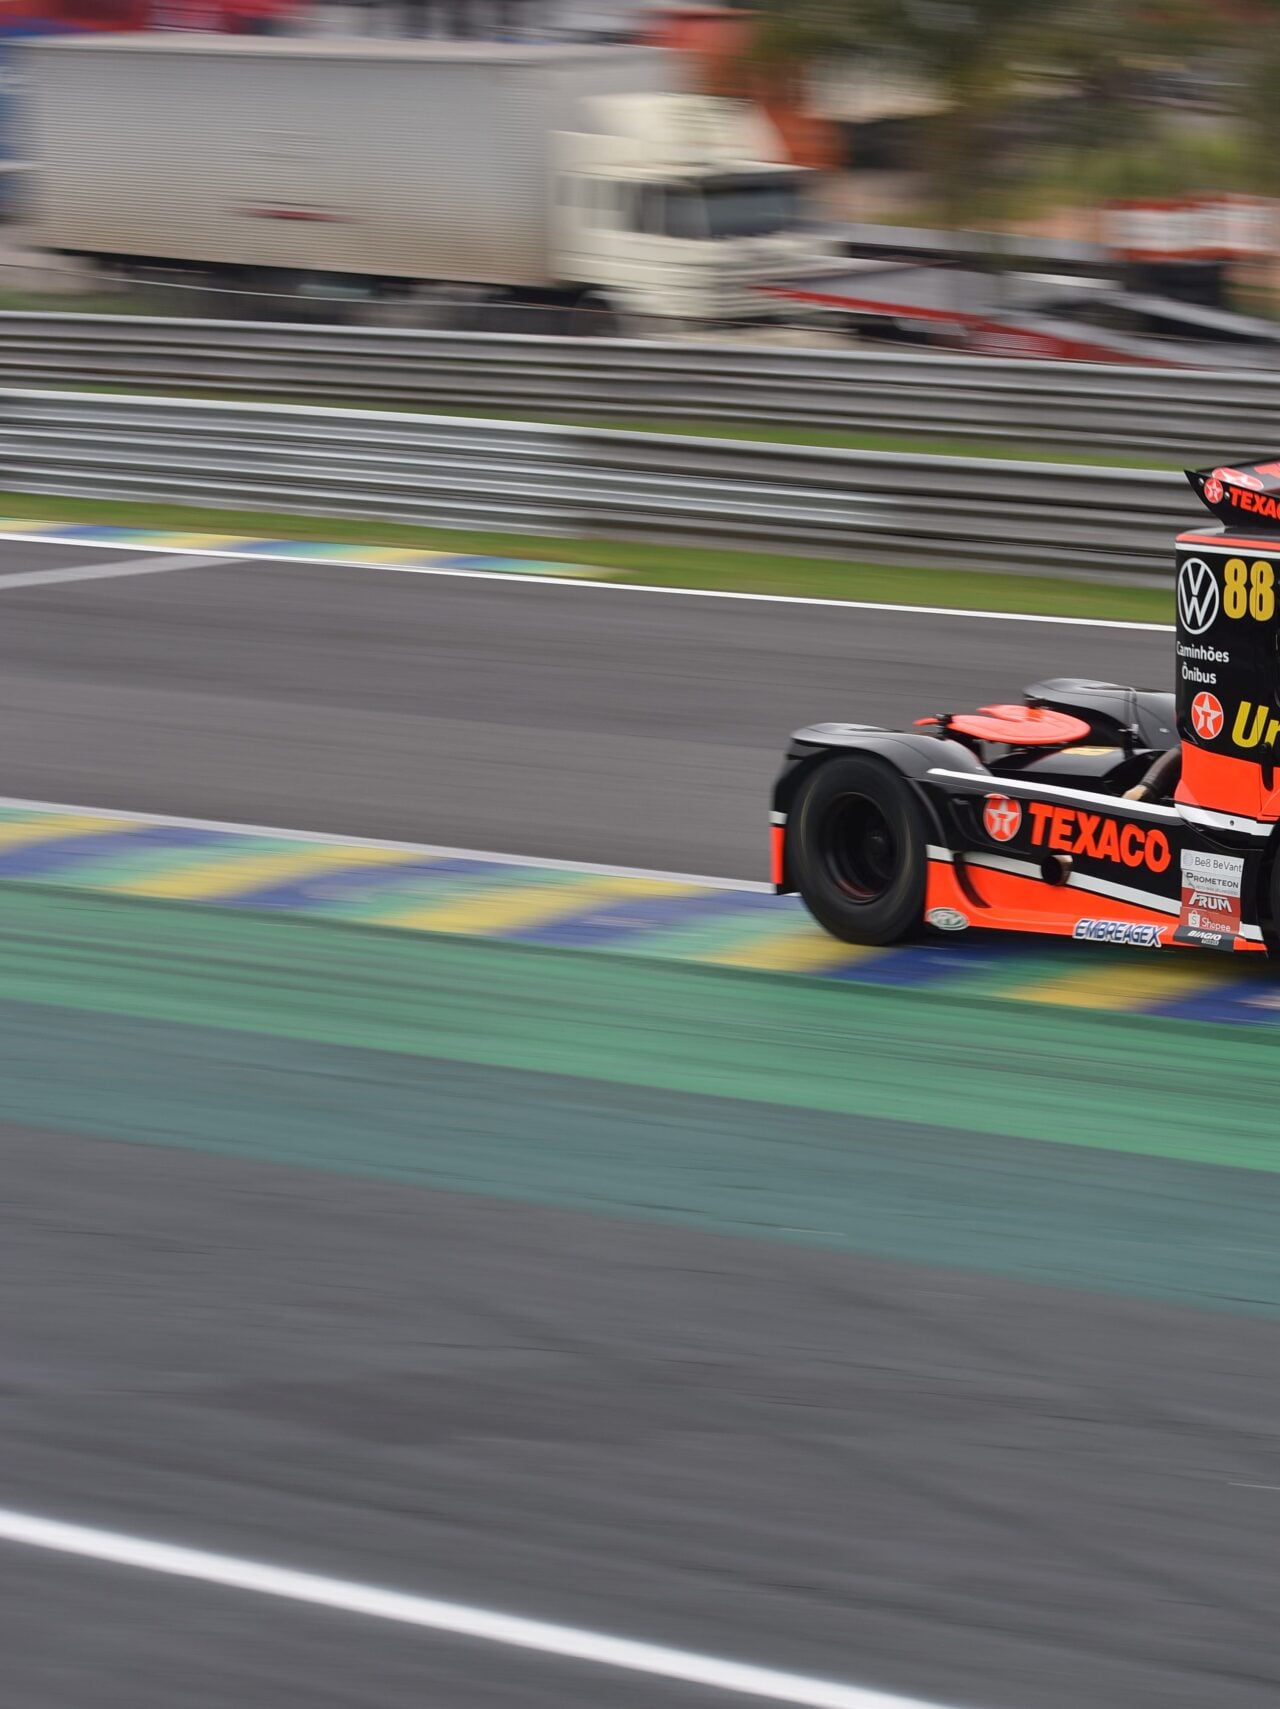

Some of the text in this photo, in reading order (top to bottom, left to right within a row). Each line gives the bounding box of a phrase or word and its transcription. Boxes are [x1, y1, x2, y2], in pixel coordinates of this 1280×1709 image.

[1223, 558, 1275, 621] 88
[1176, 641, 1230, 663] Caminhões
[1182, 661, 1217, 684] Ônibus
[1029, 802, 1171, 873] TEXACO
[1194, 857, 1242, 873] Be8 BeVant
[1189, 892, 1232, 912] FRUM
[1073, 919, 1168, 947] EMBREAGEX
[1201, 918, 1231, 932] Shopee
